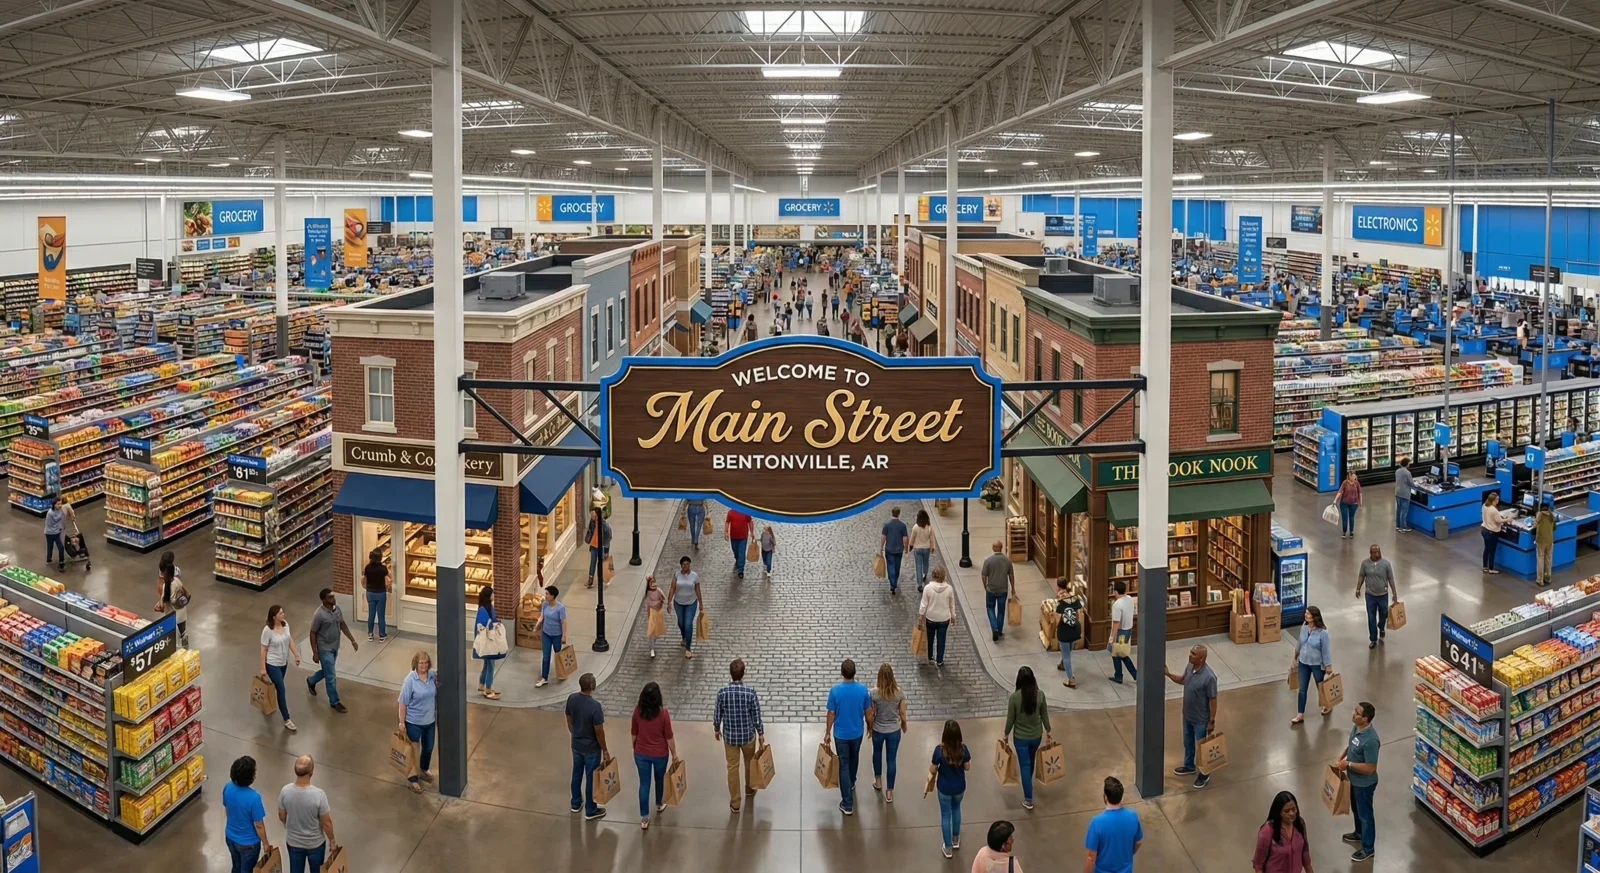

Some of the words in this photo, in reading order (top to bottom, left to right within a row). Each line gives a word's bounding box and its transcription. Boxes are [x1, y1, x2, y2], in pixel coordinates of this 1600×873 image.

[219, 209, 258, 223] GROCERY
[559, 202, 605, 213] GROCERY
[784, 203, 822, 212] GROCERY
[934, 203, 979, 214] GRCERY
[1358, 215, 1418, 232] ELECTRONICS
[731, 363, 836, 388] WELCOME
[844, 367, 871, 388] TO
[636, 388, 794, 453] Main
[803, 388, 964, 449] Street
[351, 446, 397, 464] Crumb
[401, 450, 412, 465] &
[464, 458, 494, 475] kery
[712, 454, 856, 472] BENTONVILLE,
[861, 454, 889, 470] AR
[1111, 465, 1140, 481] TH
[1167, 459, 1204, 477] OOK
[1209, 455, 1259, 474] NOOK
